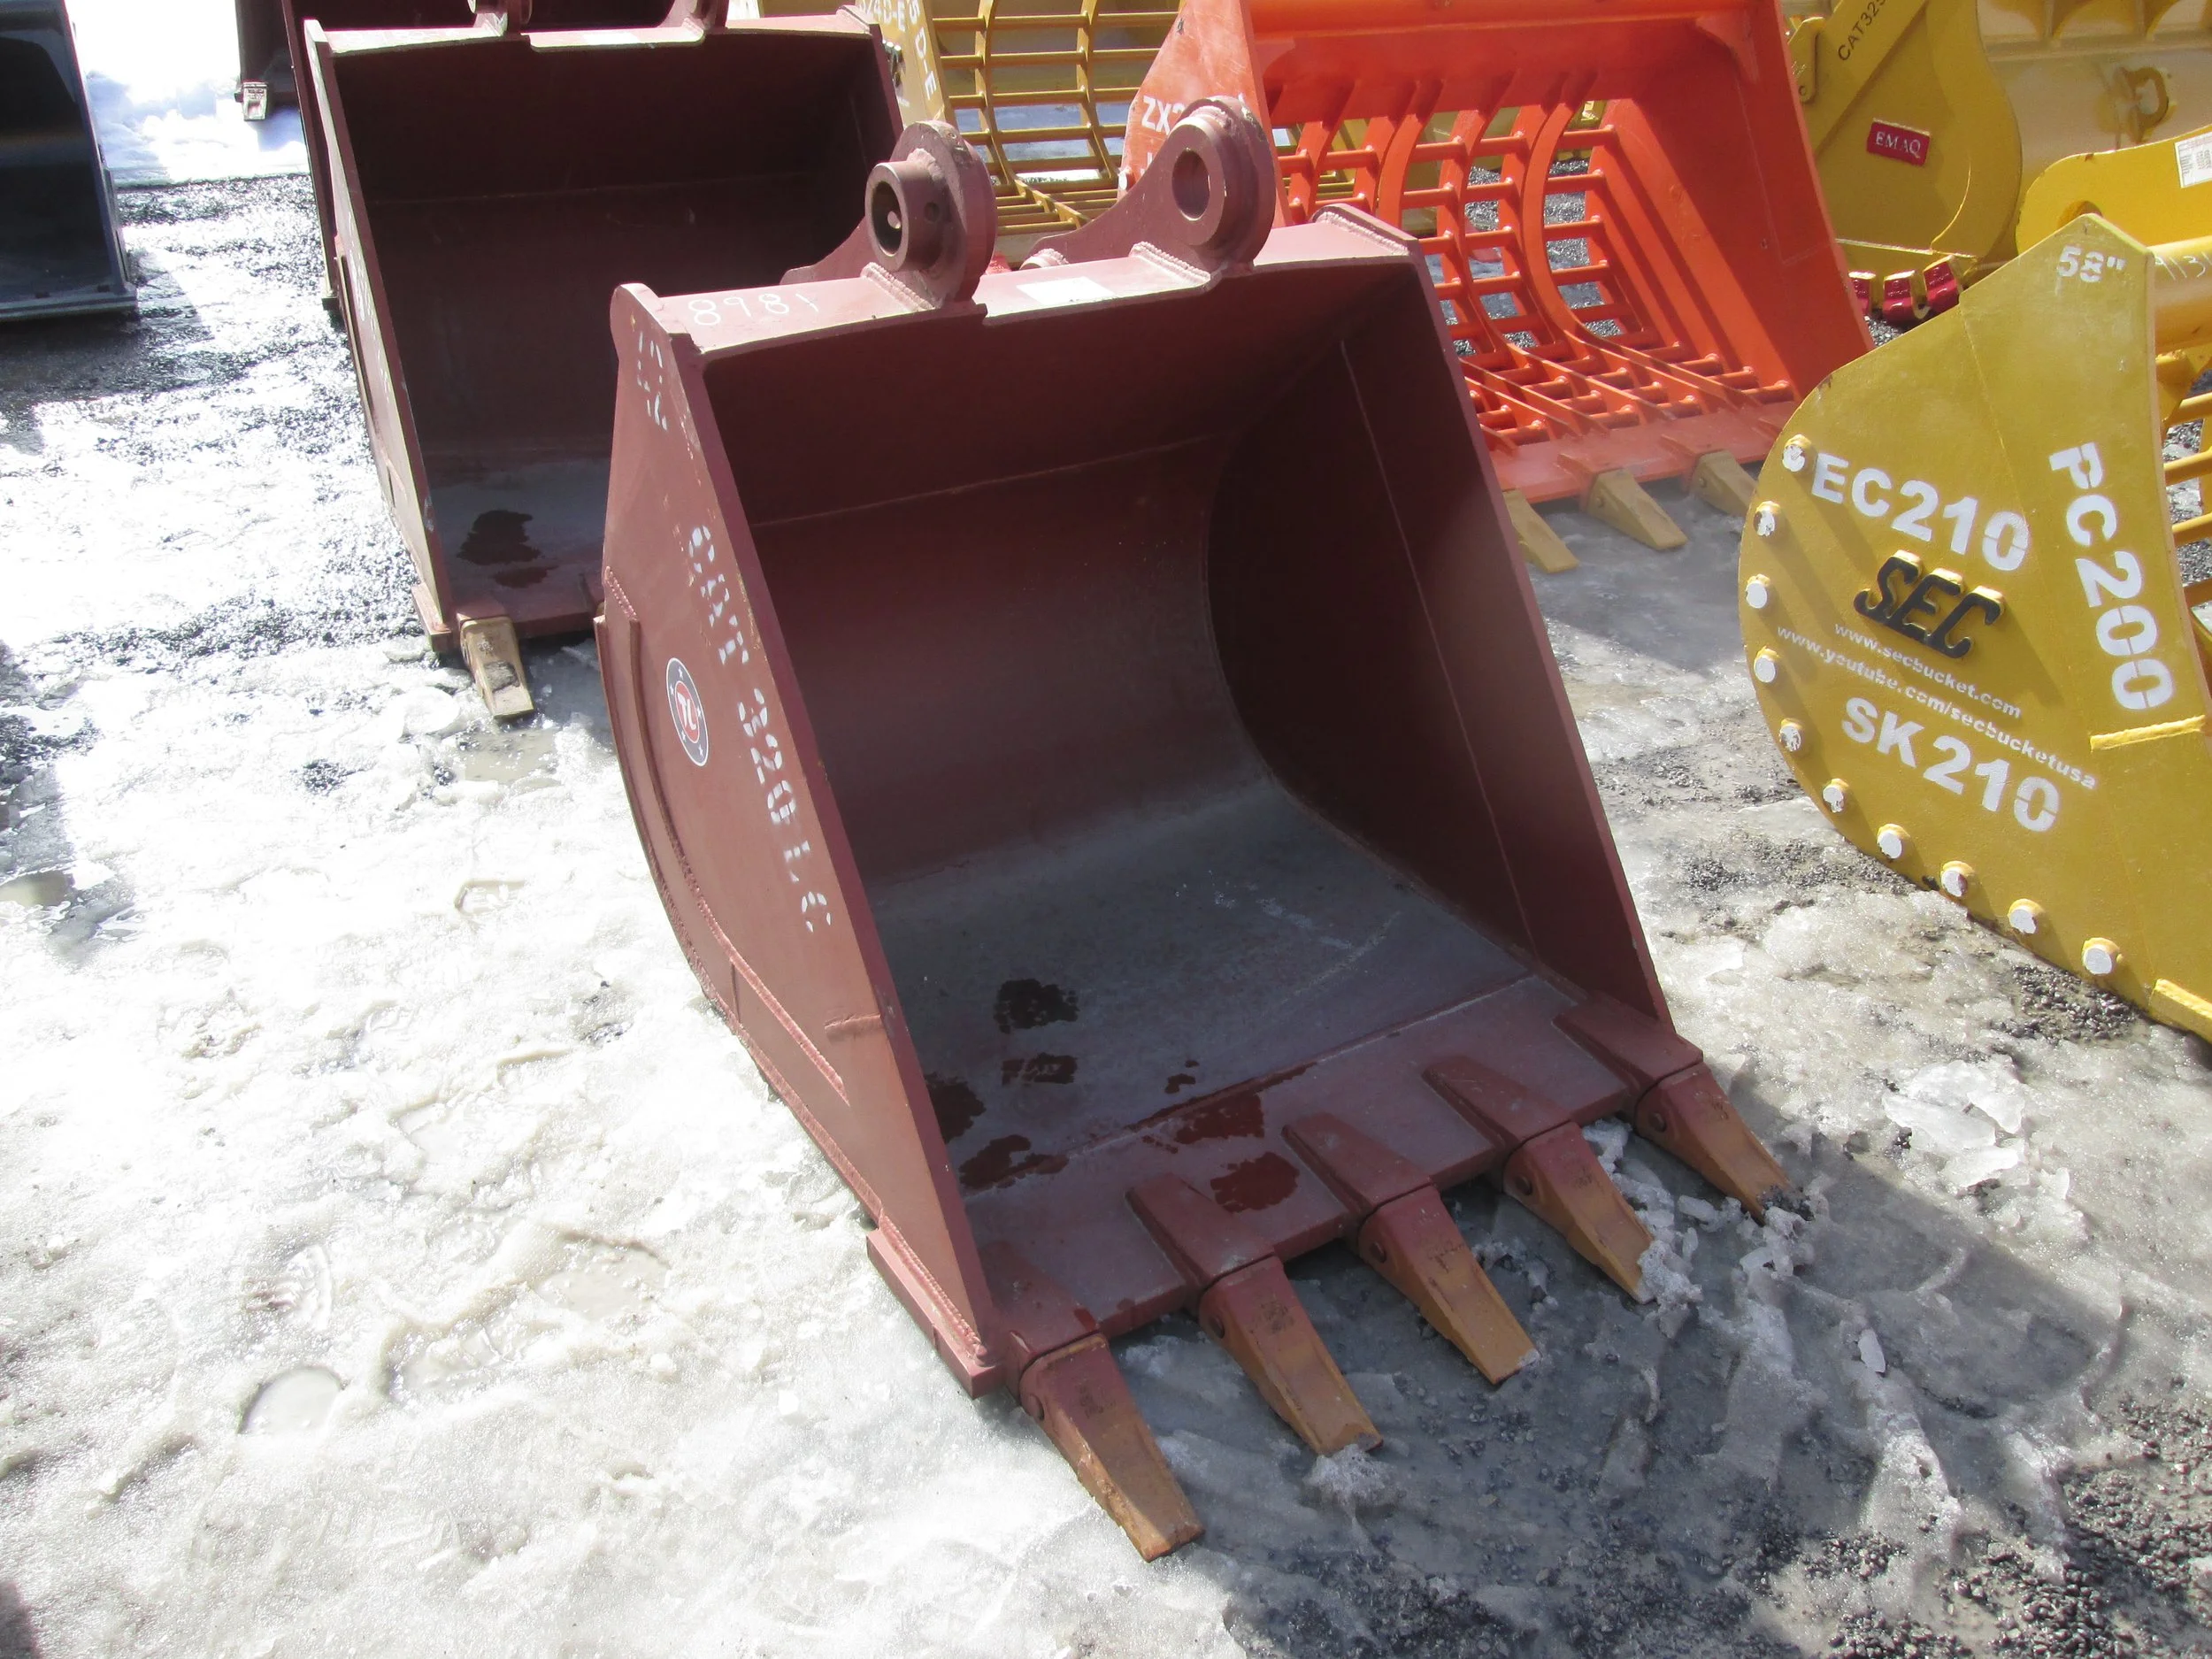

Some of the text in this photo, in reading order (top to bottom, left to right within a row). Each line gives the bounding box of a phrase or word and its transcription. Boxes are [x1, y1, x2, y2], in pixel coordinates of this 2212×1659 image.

[1875, 131, 1921, 159] EMAQ
[688, 293, 819, 326] 8981
[2057, 245, 2126, 282] 58"
[1811, 452, 2031, 571] EC210
[1853, 549, 2006, 658] SEC
[2050, 442, 2174, 710] PC200
[689, 526, 749, 665] CAT
[738, 688, 796, 824] 320
[1777, 626, 2096, 789] www.youtube.com/secbucketusa
[1834, 623, 2022, 718] www.secbucket.com
